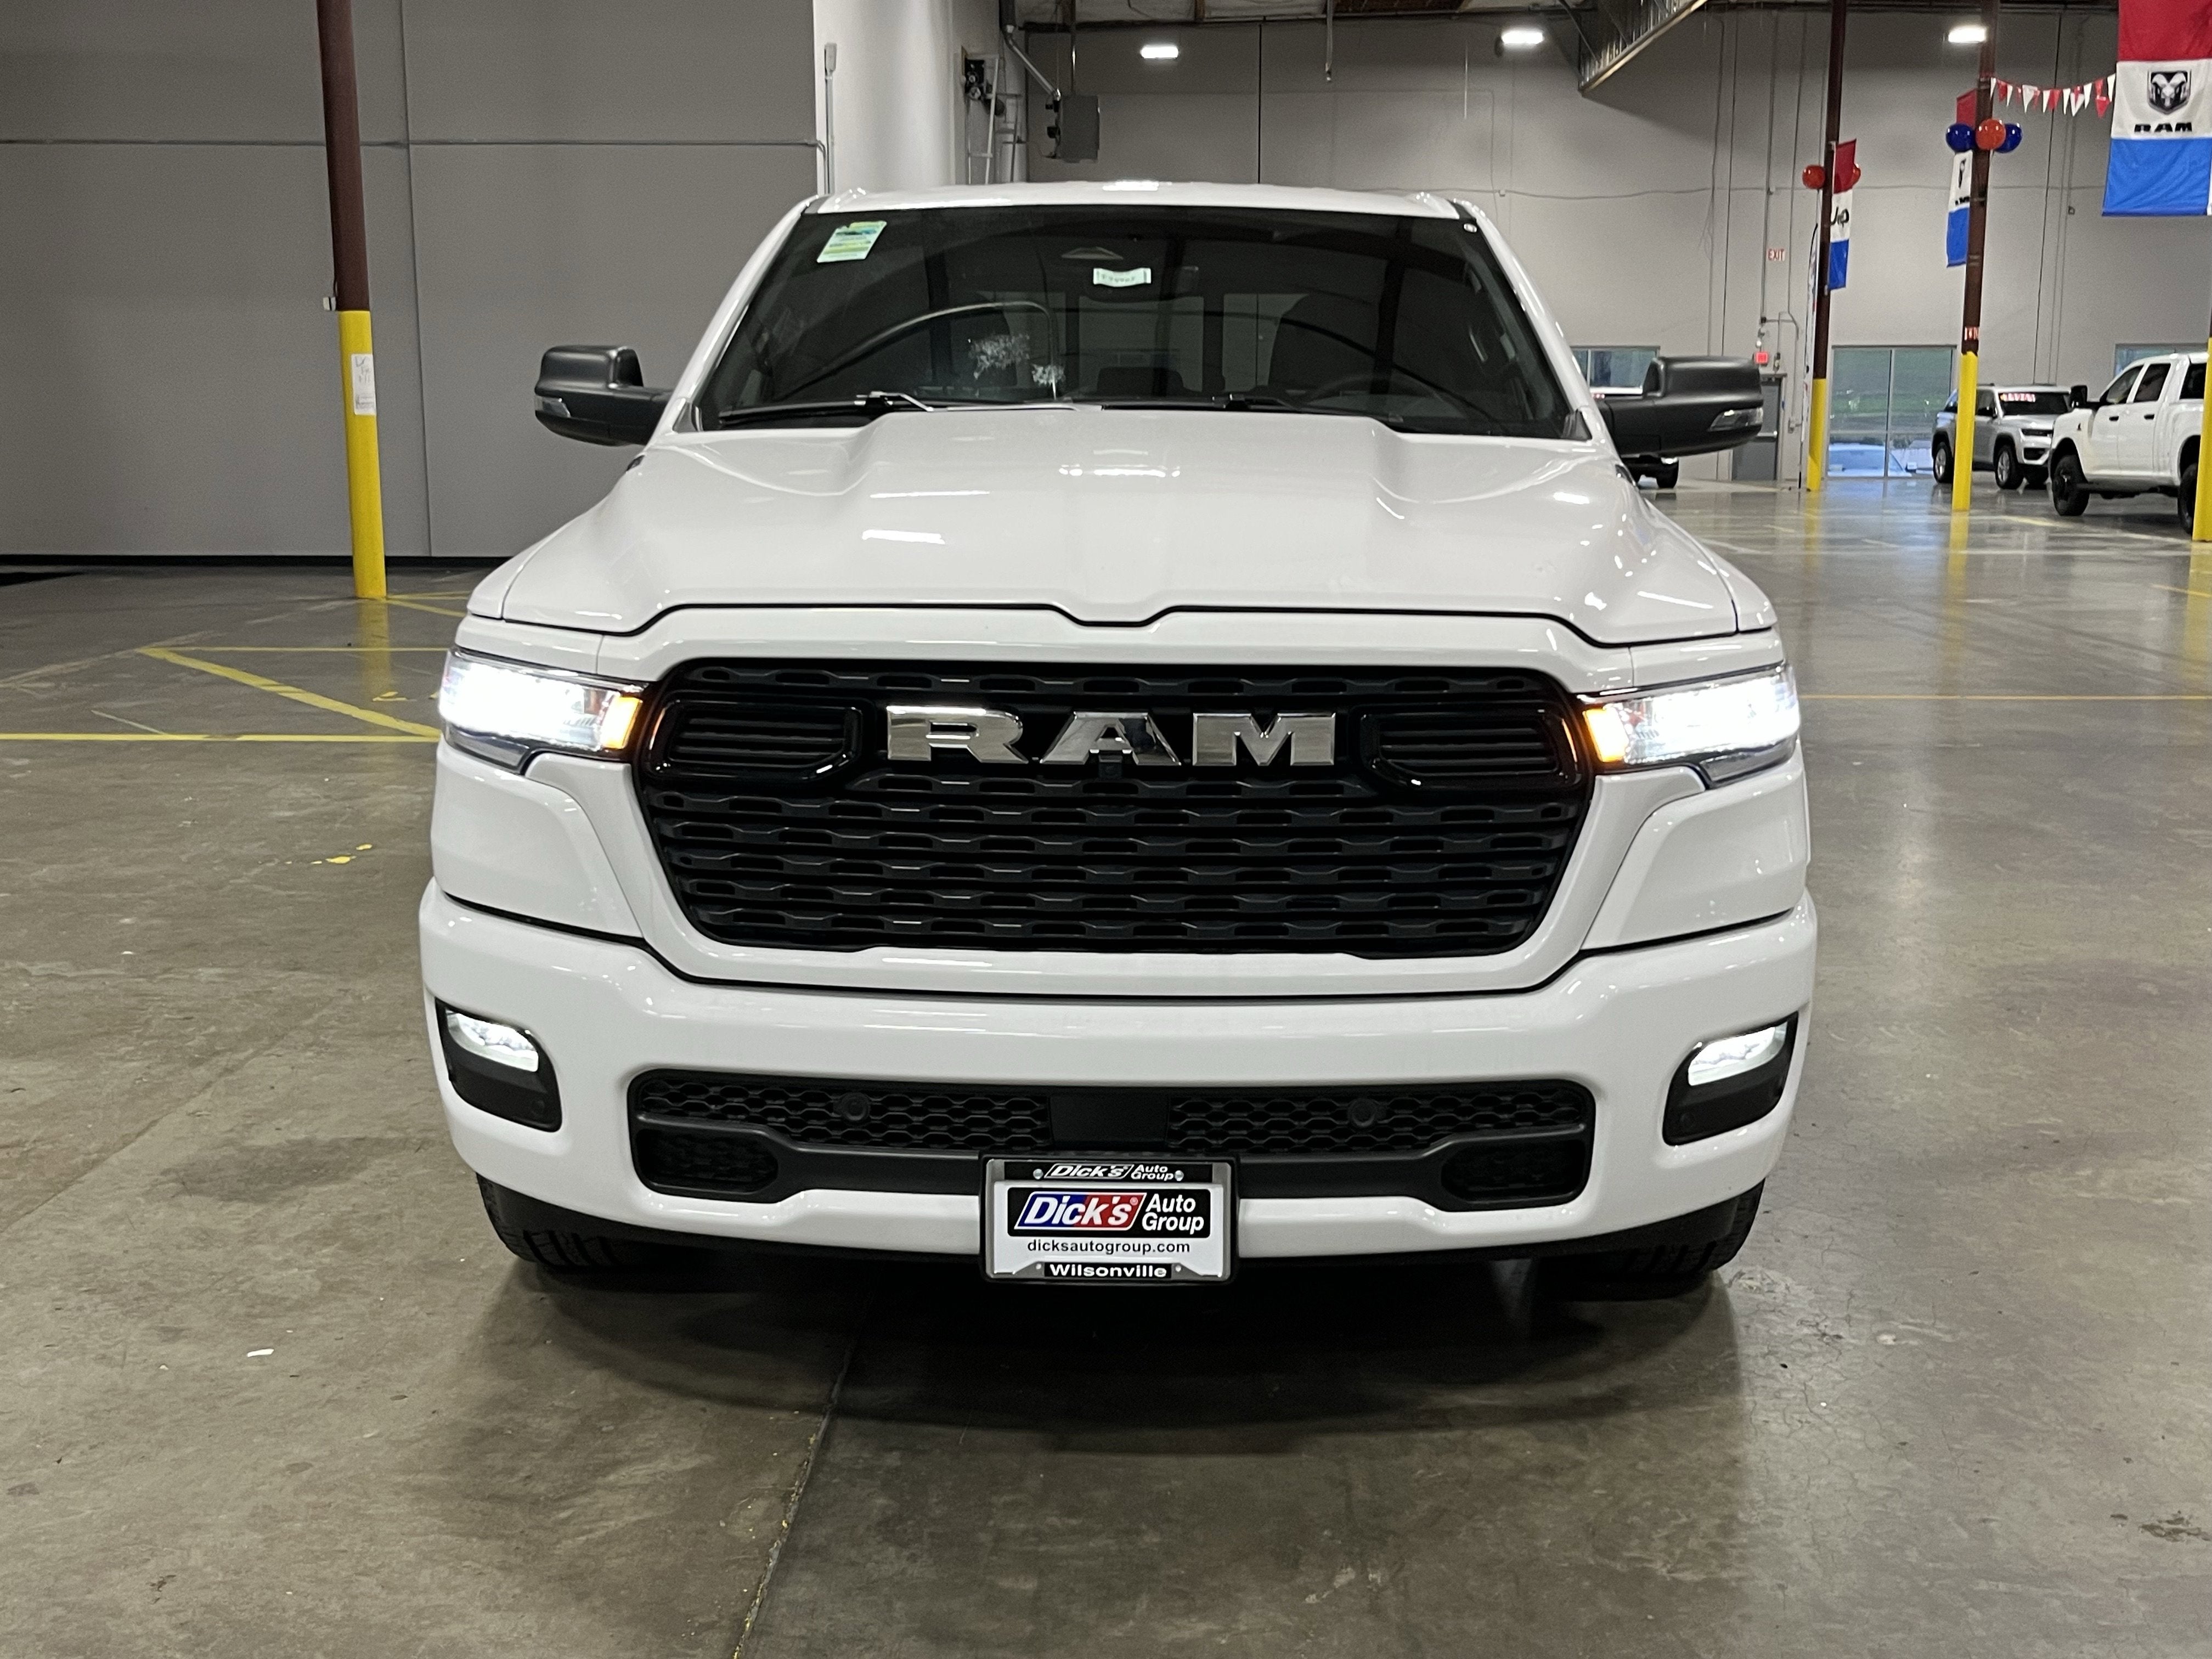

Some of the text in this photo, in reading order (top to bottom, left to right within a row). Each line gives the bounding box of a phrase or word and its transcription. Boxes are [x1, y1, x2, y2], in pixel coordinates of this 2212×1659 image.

[2134, 122, 2192, 132] RAM
[1768, 249, 1785, 261] EXIT
[886, 706, 1336, 766] RAM
[1051, 1164, 1124, 1177] Dick's
[1135, 1164, 1168, 1173] Auto
[1131, 1172, 1174, 1181] Group
[1146, 1193, 1196, 1212] Auto
[1024, 1195, 1132, 1226] Dick's
[1142, 1213, 1204, 1234] Group
[1027, 1239, 1190, 1255] dicksautogroup.com
[1049, 1263, 1167, 1278] Wilsonville
